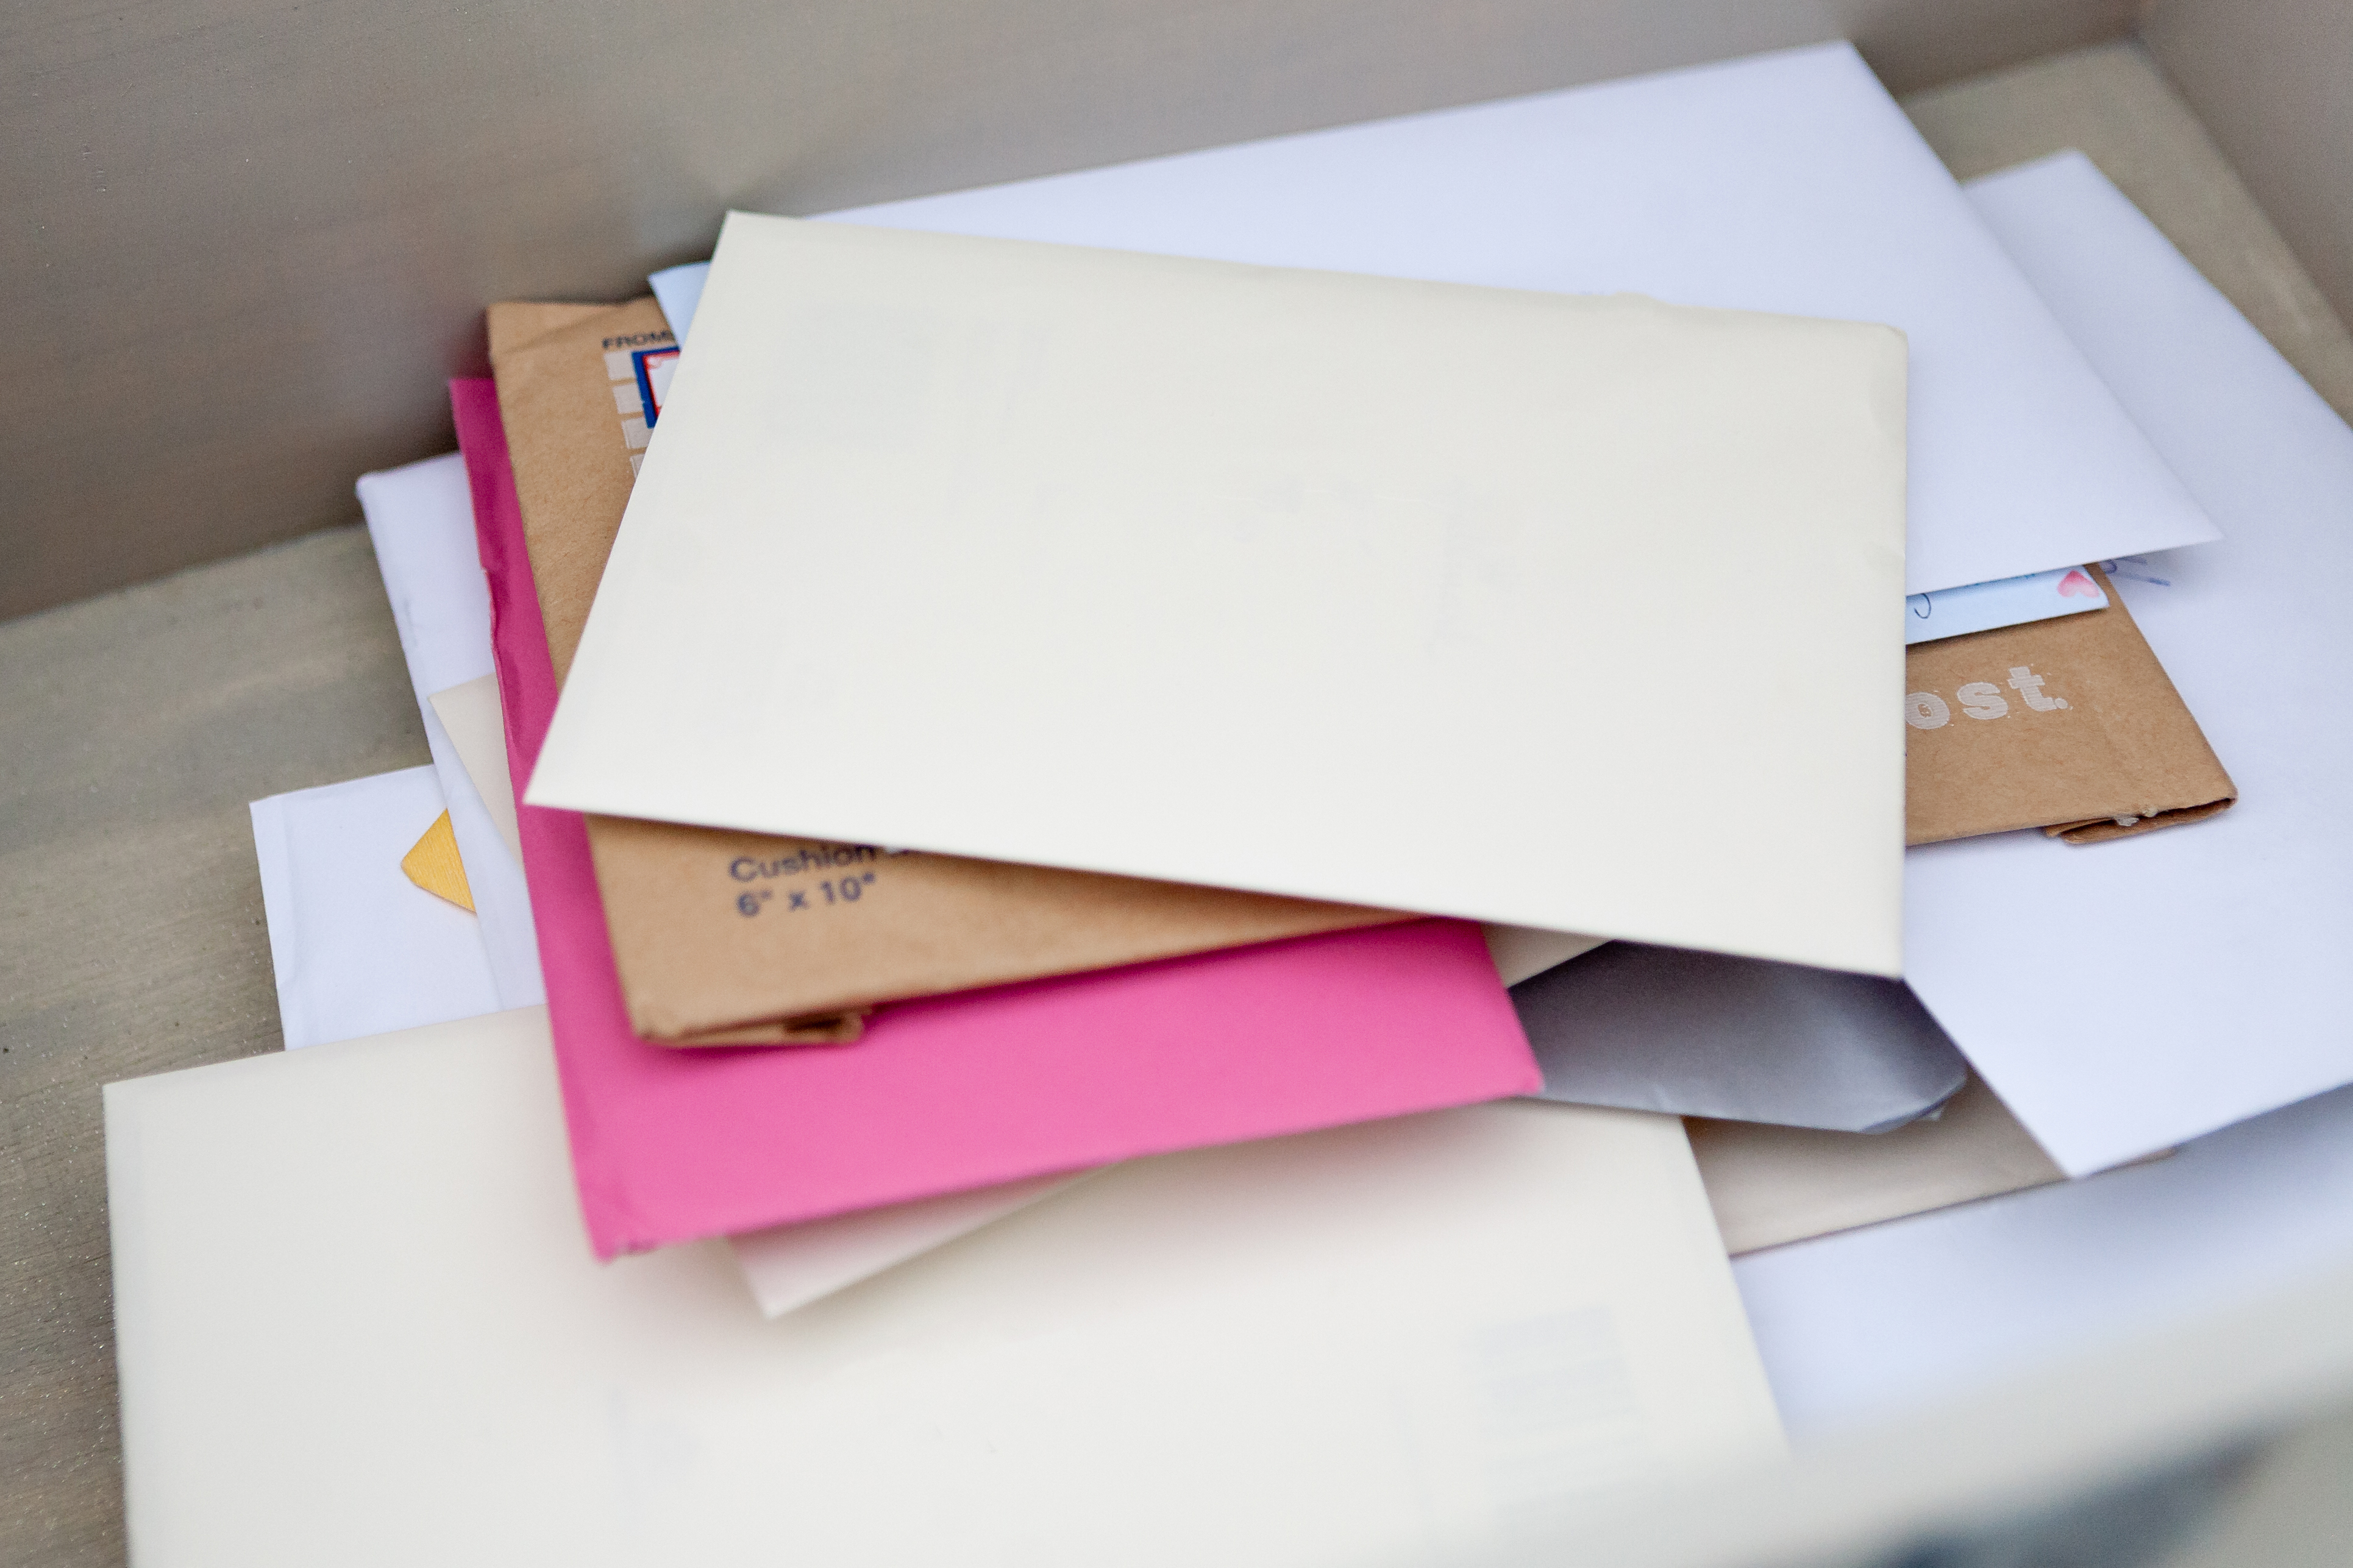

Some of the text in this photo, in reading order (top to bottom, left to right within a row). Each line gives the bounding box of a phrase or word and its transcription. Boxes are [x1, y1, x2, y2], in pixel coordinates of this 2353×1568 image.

[729, 843, 876, 882] Cushion
[789, 890, 811, 912] x
[821, 872, 875, 903] 10"
